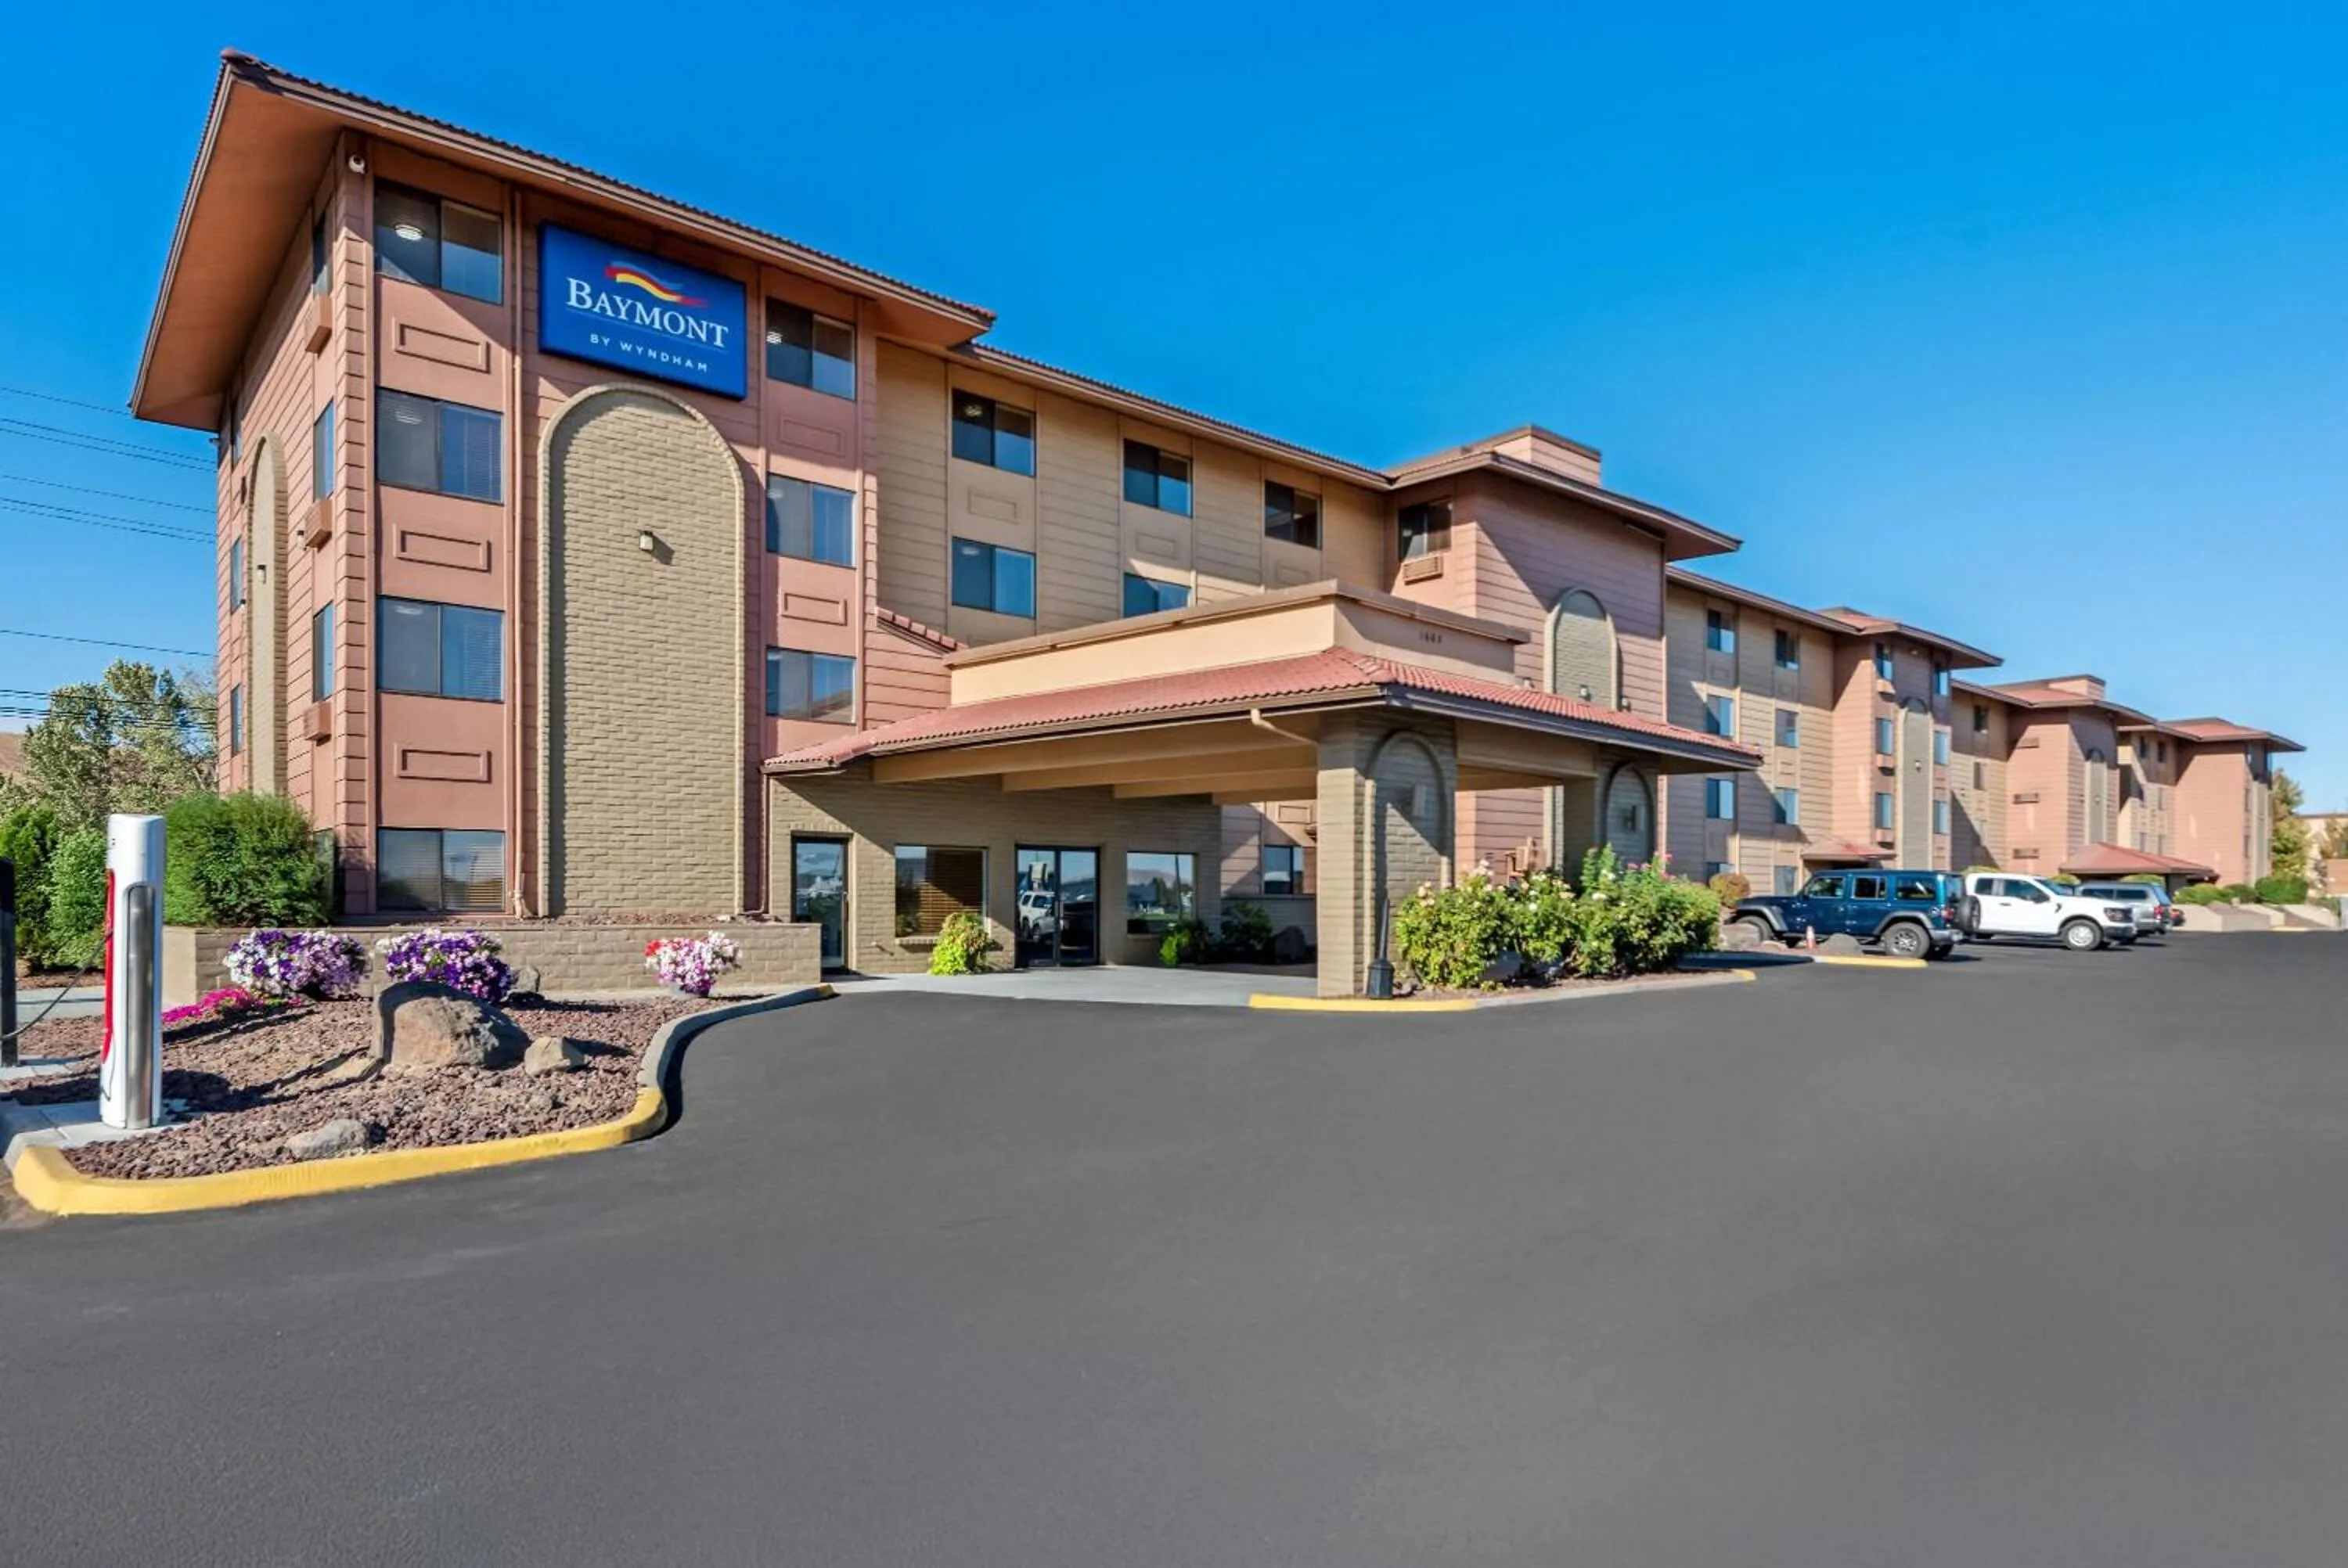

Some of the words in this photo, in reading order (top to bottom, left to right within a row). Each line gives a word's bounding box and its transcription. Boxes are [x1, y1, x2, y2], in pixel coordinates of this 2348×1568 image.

[565, 276, 729, 348] BAYMONT
[589, 333, 610, 347] BY
[620, 341, 708, 372] WYNDHAM
